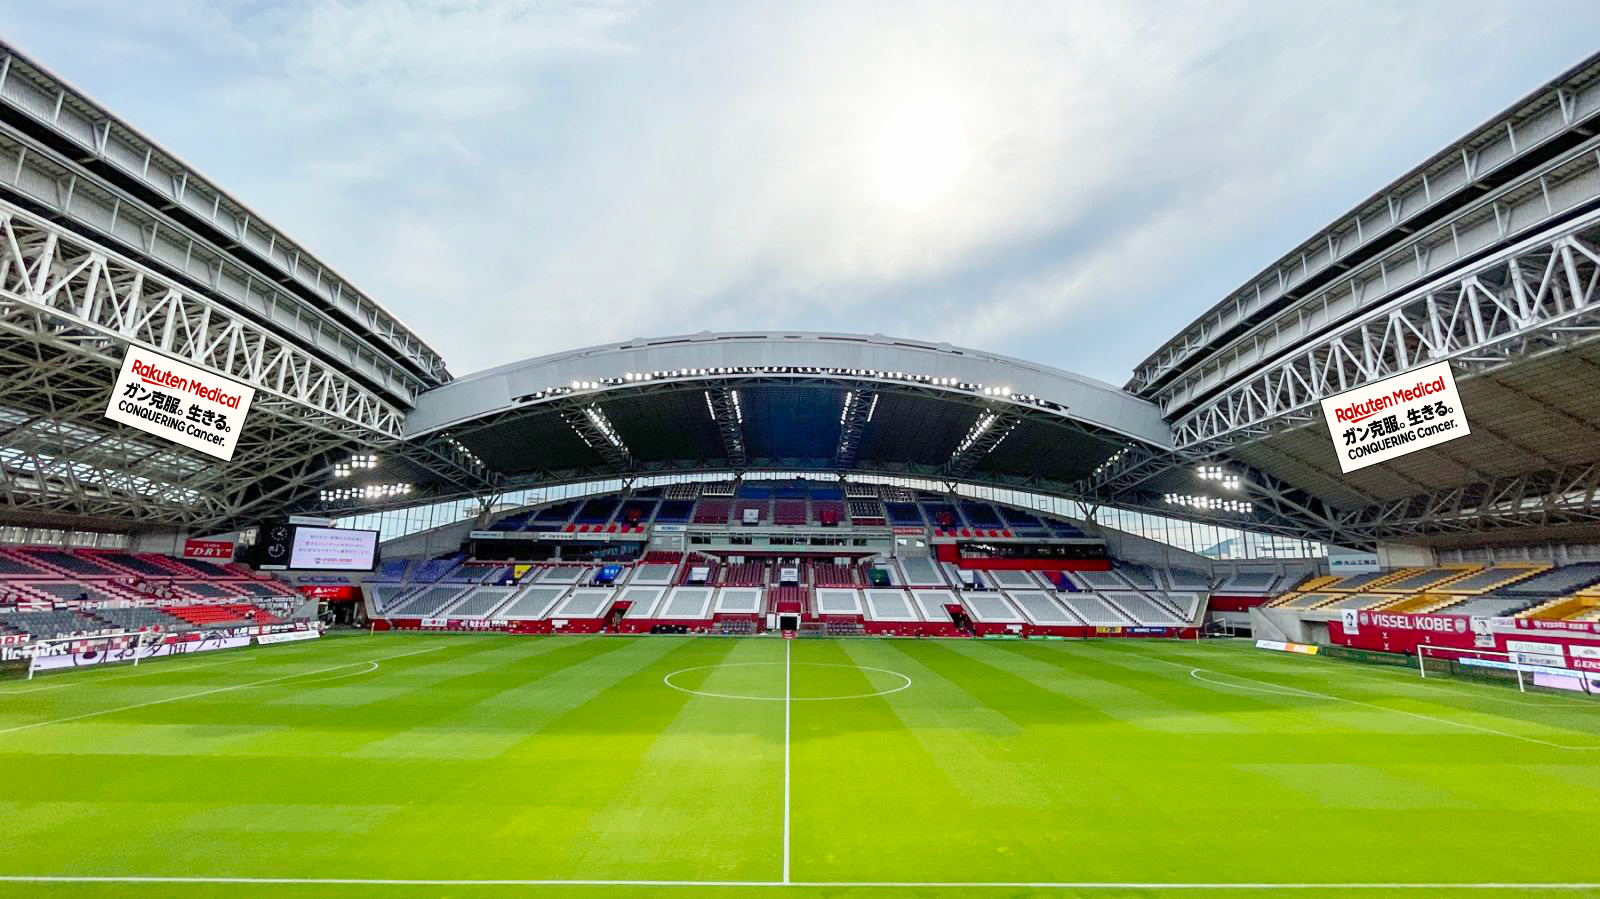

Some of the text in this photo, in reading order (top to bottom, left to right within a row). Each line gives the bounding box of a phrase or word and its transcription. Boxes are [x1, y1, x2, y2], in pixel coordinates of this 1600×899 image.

[131, 359, 241, 409] Rakuten Medical
[1335, 375, 1446, 423] Rakuten Medical
[118, 400, 225, 447] CONQUERING Cancer.
[1348, 419, 1458, 460] CONQUERING Cancer.
[1371, 614, 1454, 632] VISSEL KOBE
